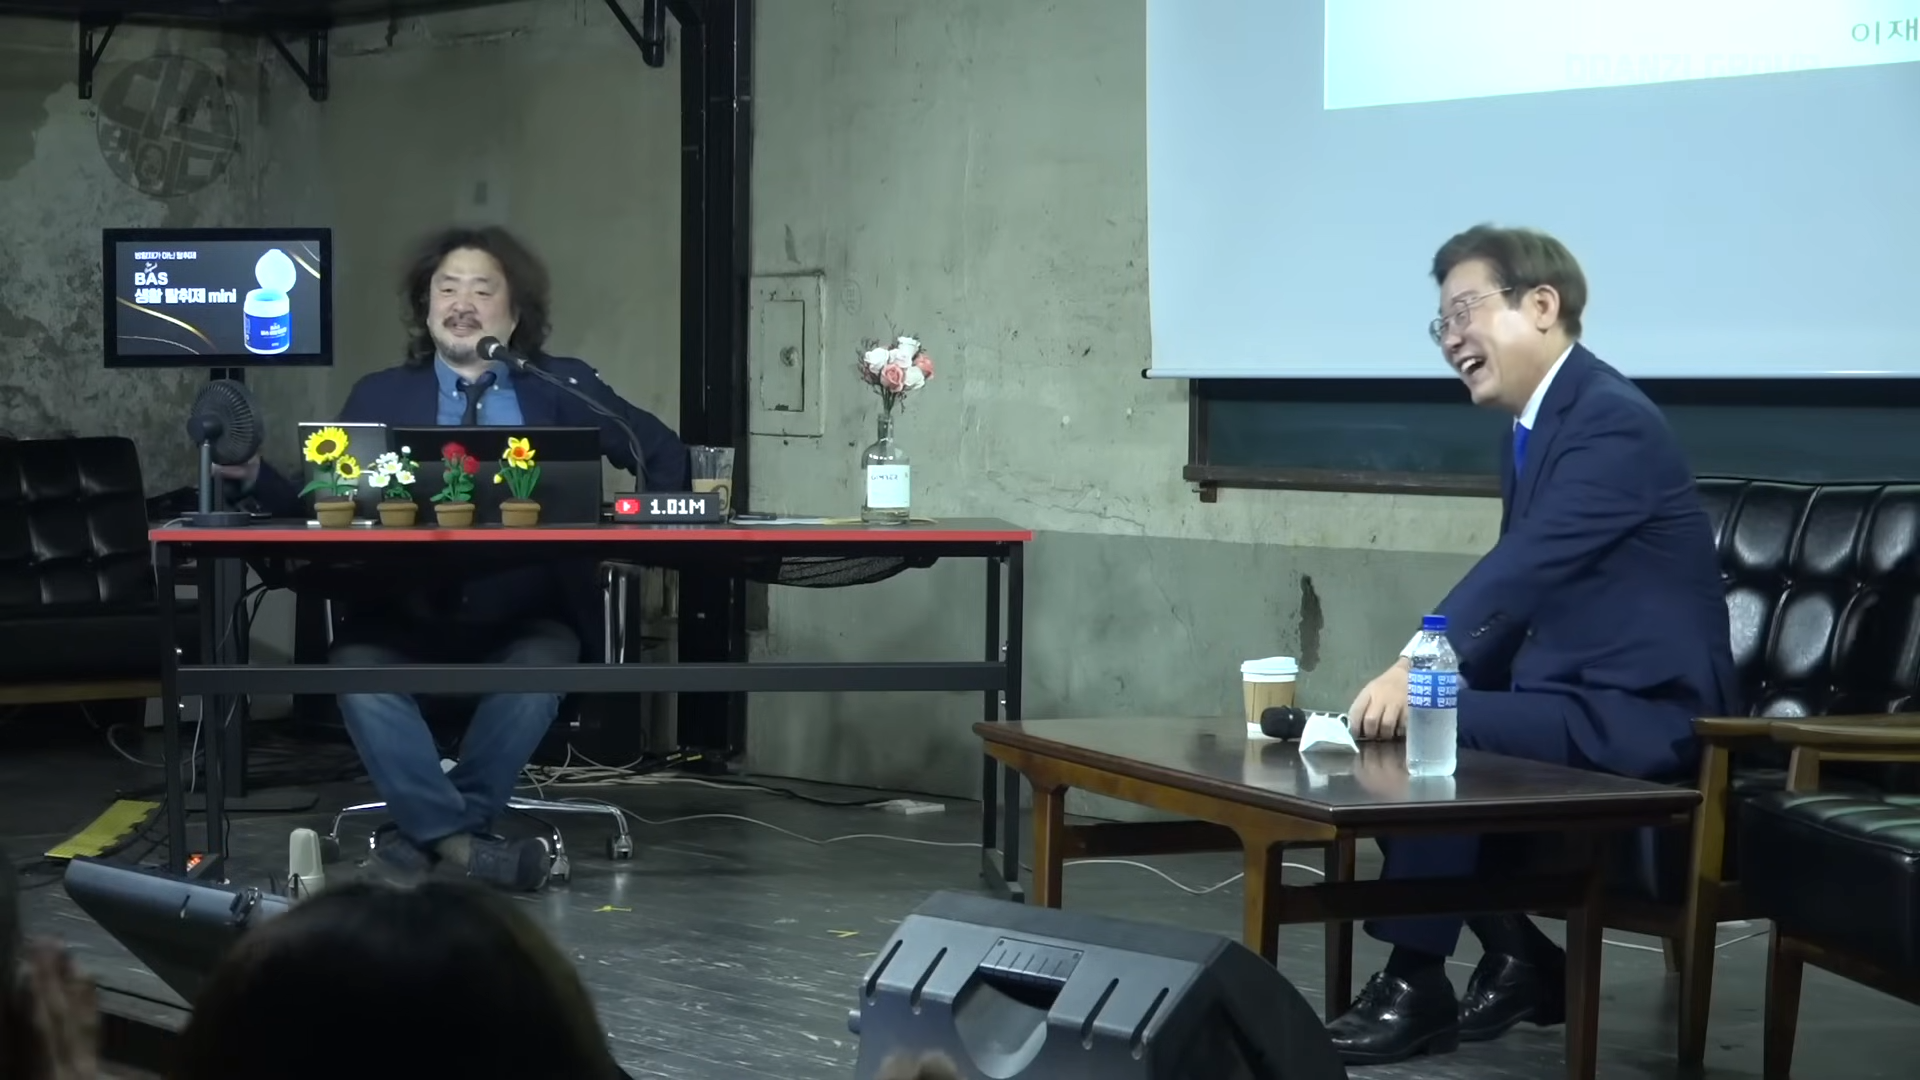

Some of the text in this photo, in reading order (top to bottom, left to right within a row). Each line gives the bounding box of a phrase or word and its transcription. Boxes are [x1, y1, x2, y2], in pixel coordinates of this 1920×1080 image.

[1851, 17, 1918, 46] 이재
[134, 271, 169, 286] BAS
[134, 287, 237, 304] 생활 탈취제 mini
[650, 498, 706, 515] 1.01M
